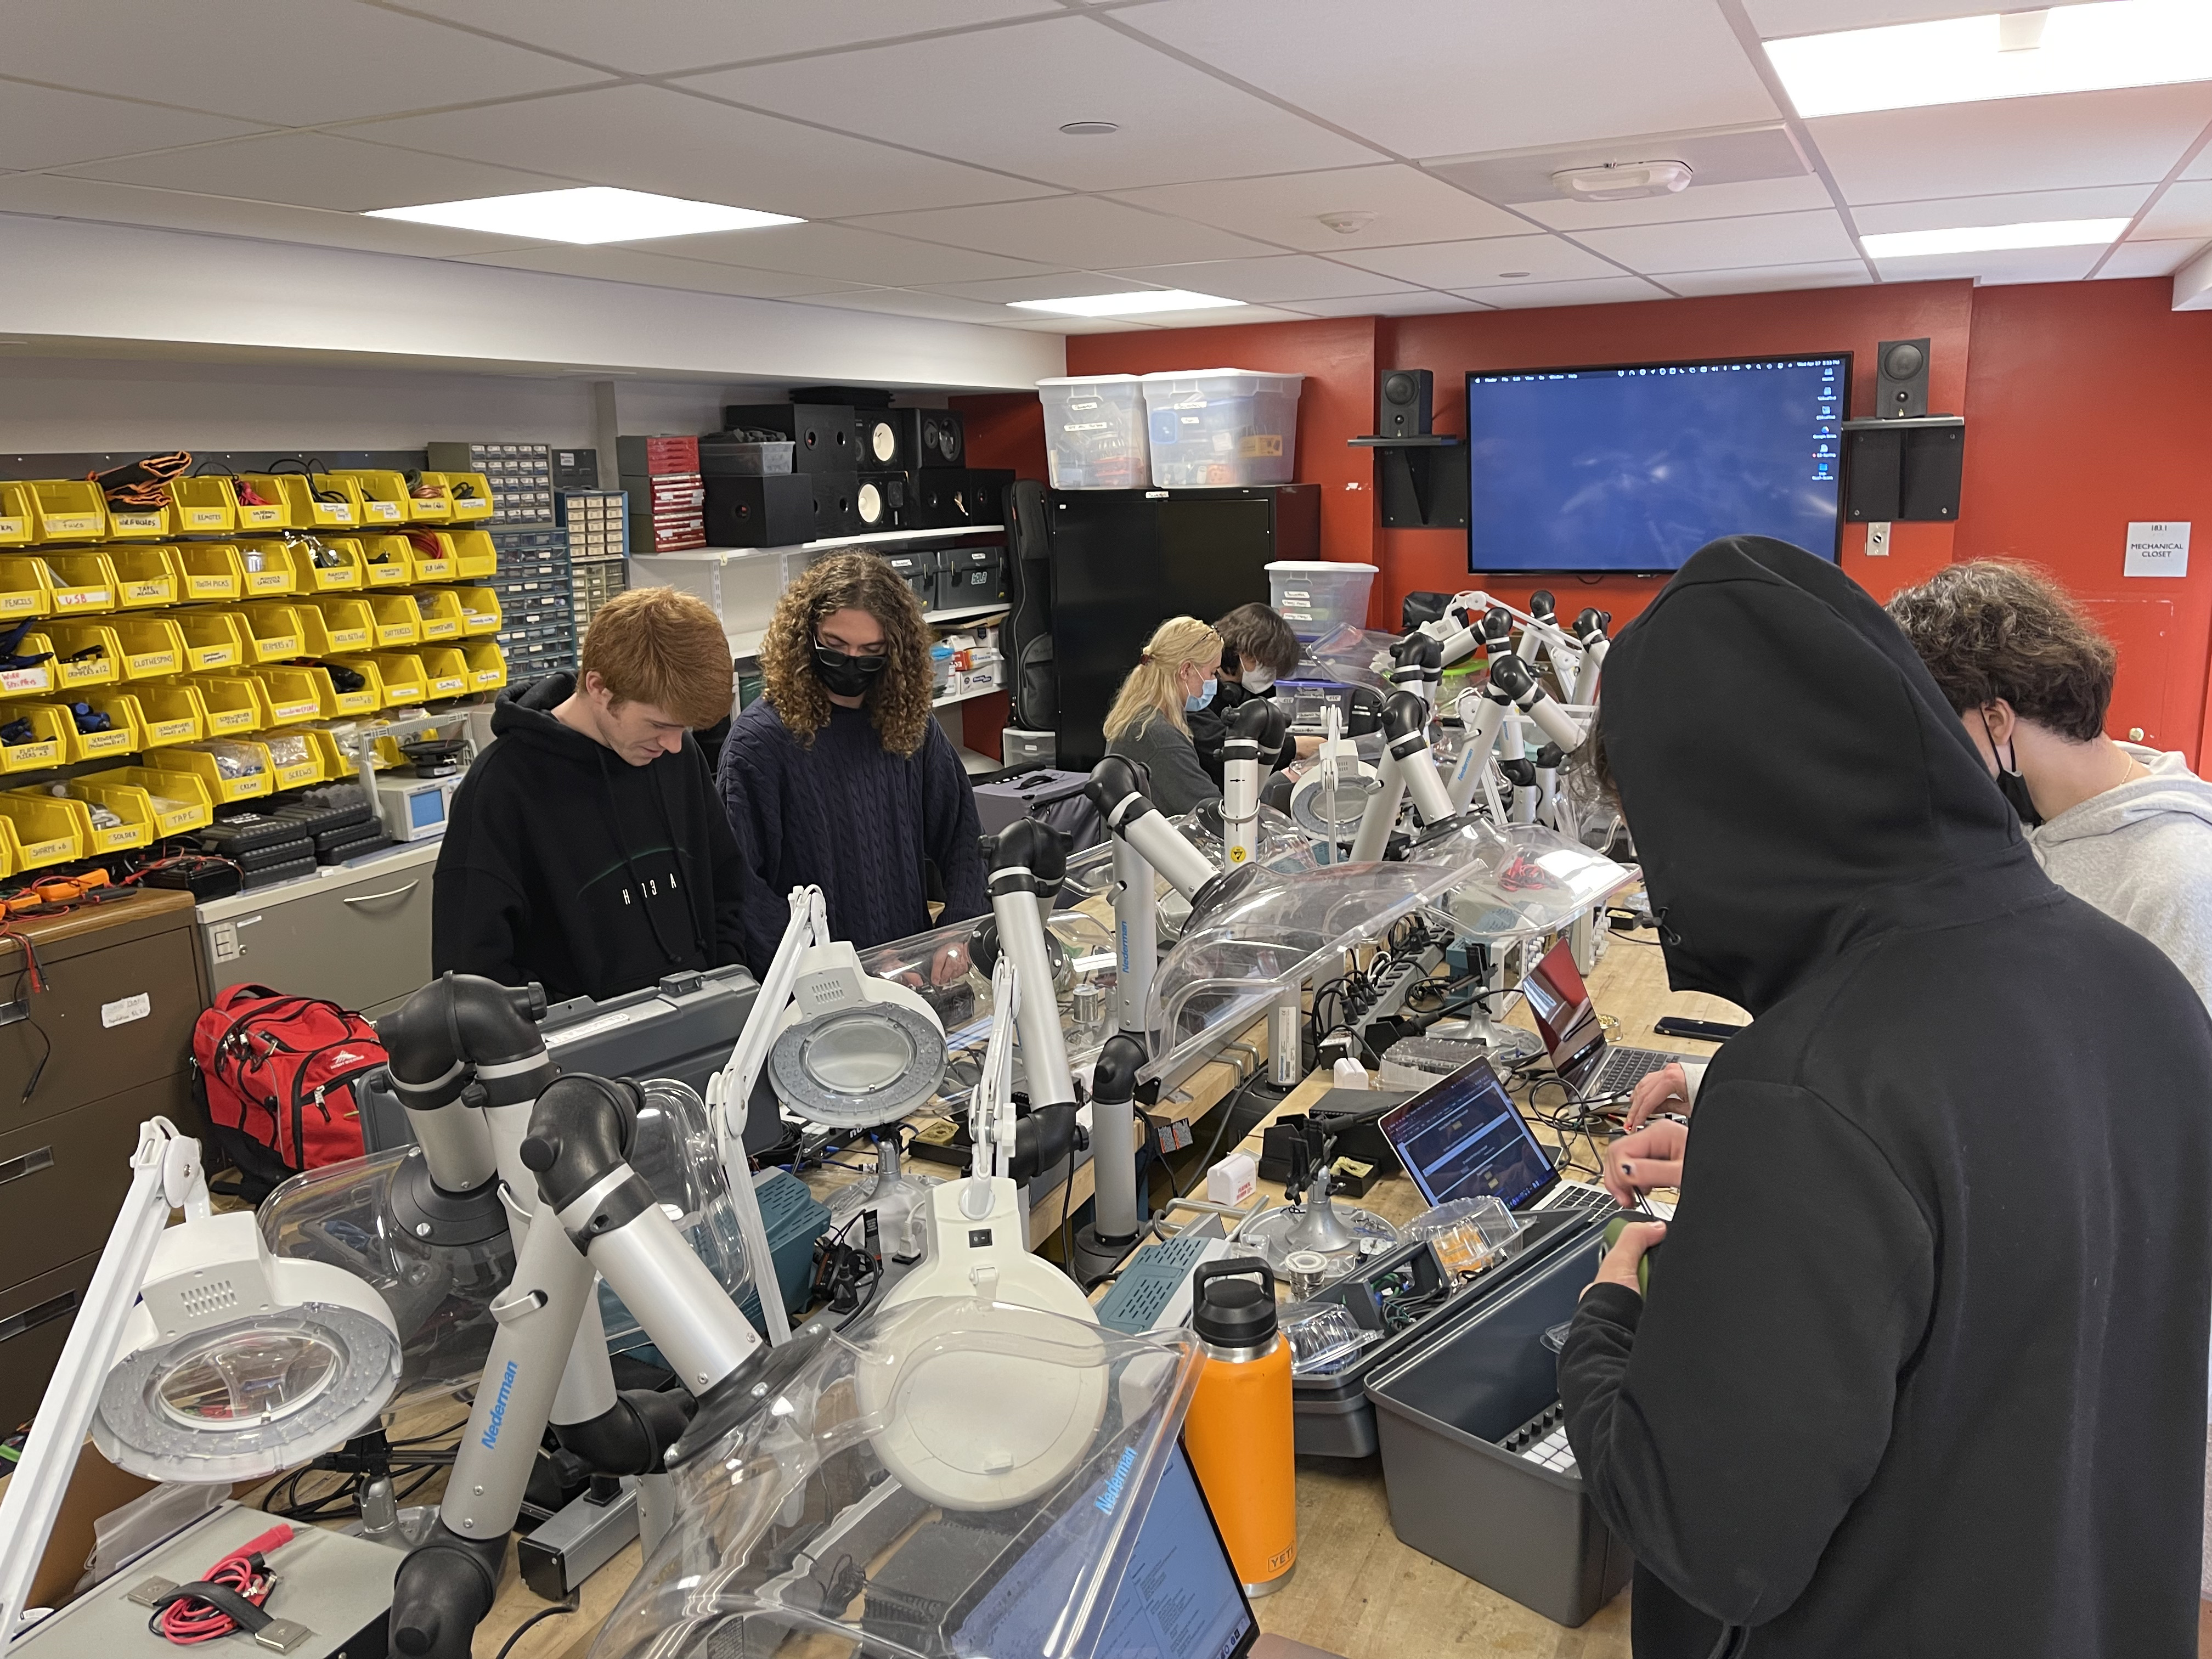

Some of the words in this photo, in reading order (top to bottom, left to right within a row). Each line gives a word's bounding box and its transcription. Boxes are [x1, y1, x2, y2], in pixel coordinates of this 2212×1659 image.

[65, 593, 87, 605] USB
[385, 627, 411, 637] BATTERIES
[134, 655, 173, 668] CLOTHESPINS
[289, 768, 312, 779] SCREWS
[172, 811, 194, 823] TAPE
[113, 832, 136, 840] SOLDER
[622, 889, 630, 905] H
[670, 873, 677, 889] A
[215, 929, 233, 957] E
[481, 1360, 518, 1449] Nederman
[1093, 1446, 1138, 1515] Nederman
[1271, 1544, 1293, 1567] YETI
